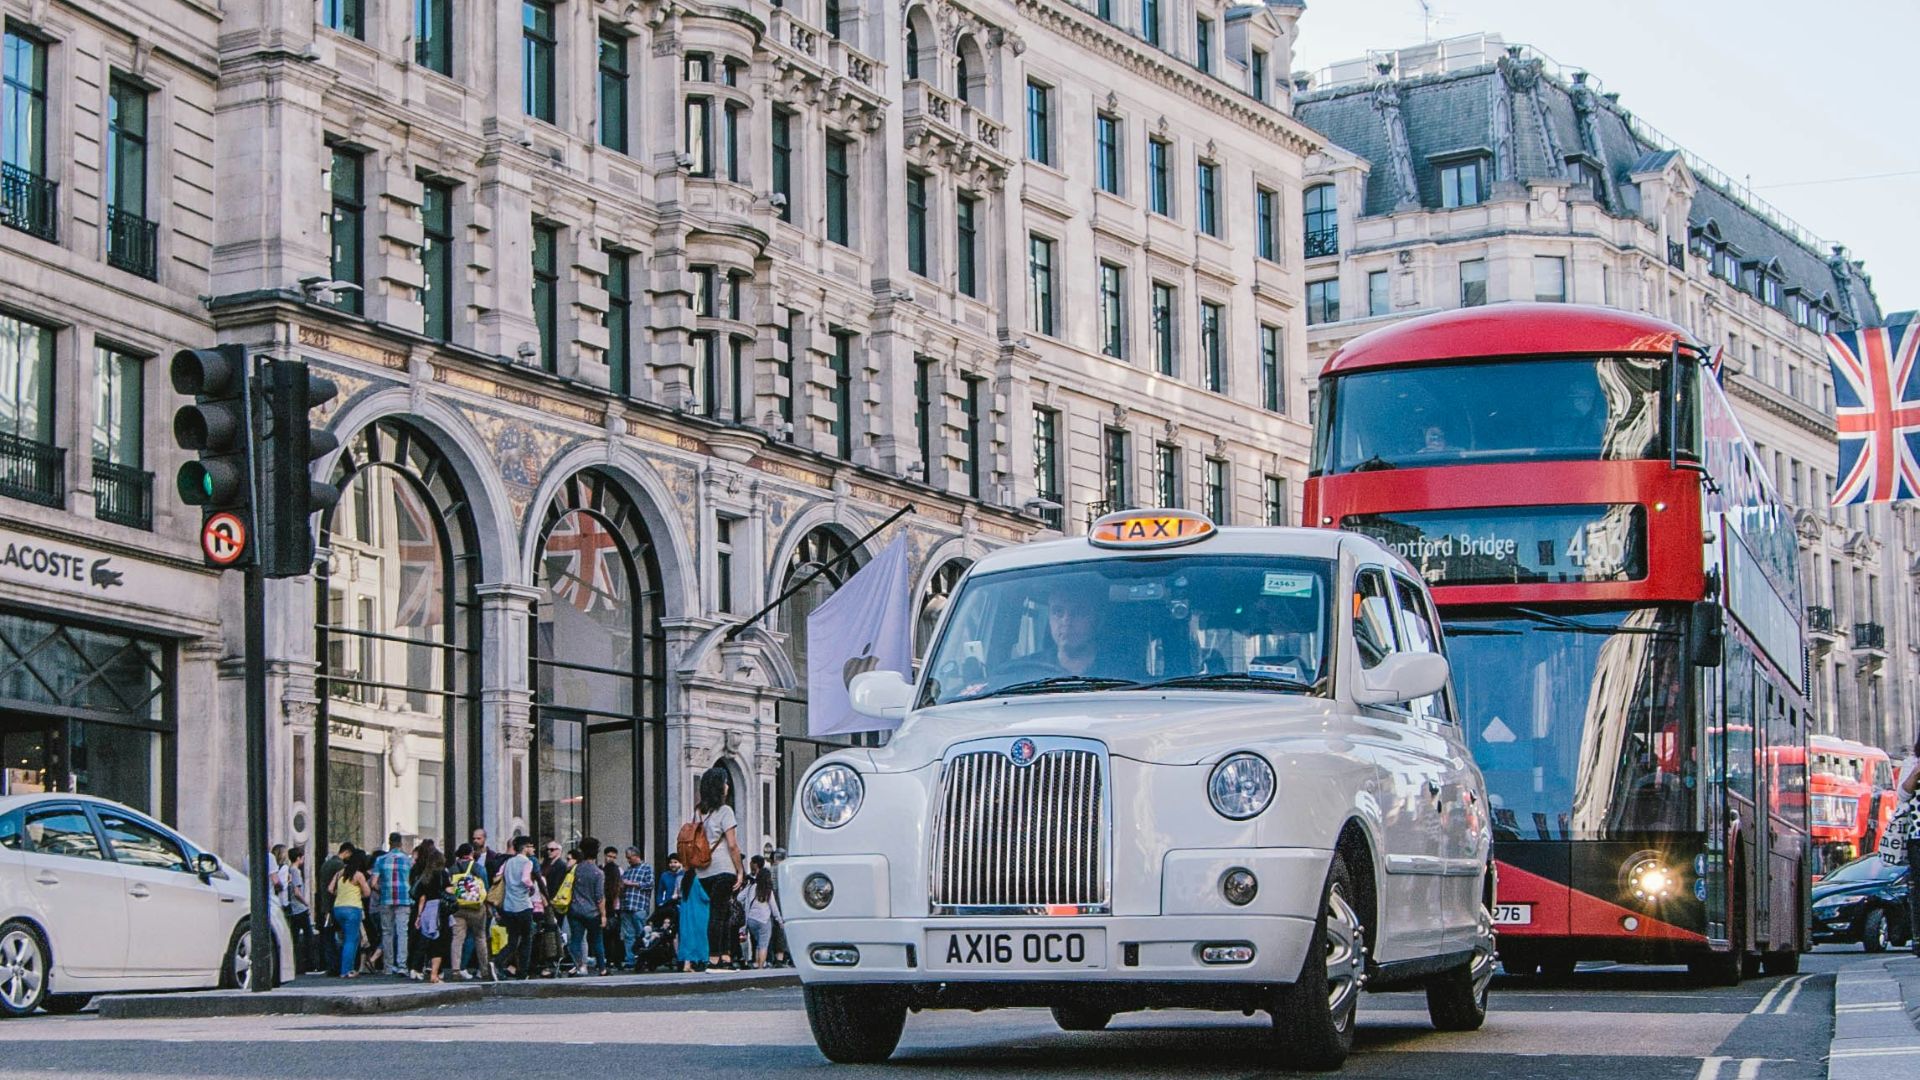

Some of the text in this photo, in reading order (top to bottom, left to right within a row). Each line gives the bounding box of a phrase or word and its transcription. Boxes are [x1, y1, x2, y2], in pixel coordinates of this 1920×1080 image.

[1112, 519, 1183, 541] TAXI
[1460, 532, 1515, 560] Bridge
[0, 542, 85, 582] ACOSTE
[1493, 906, 1521, 921] 276
[946, 933, 1085, 963] AX16 OCO
